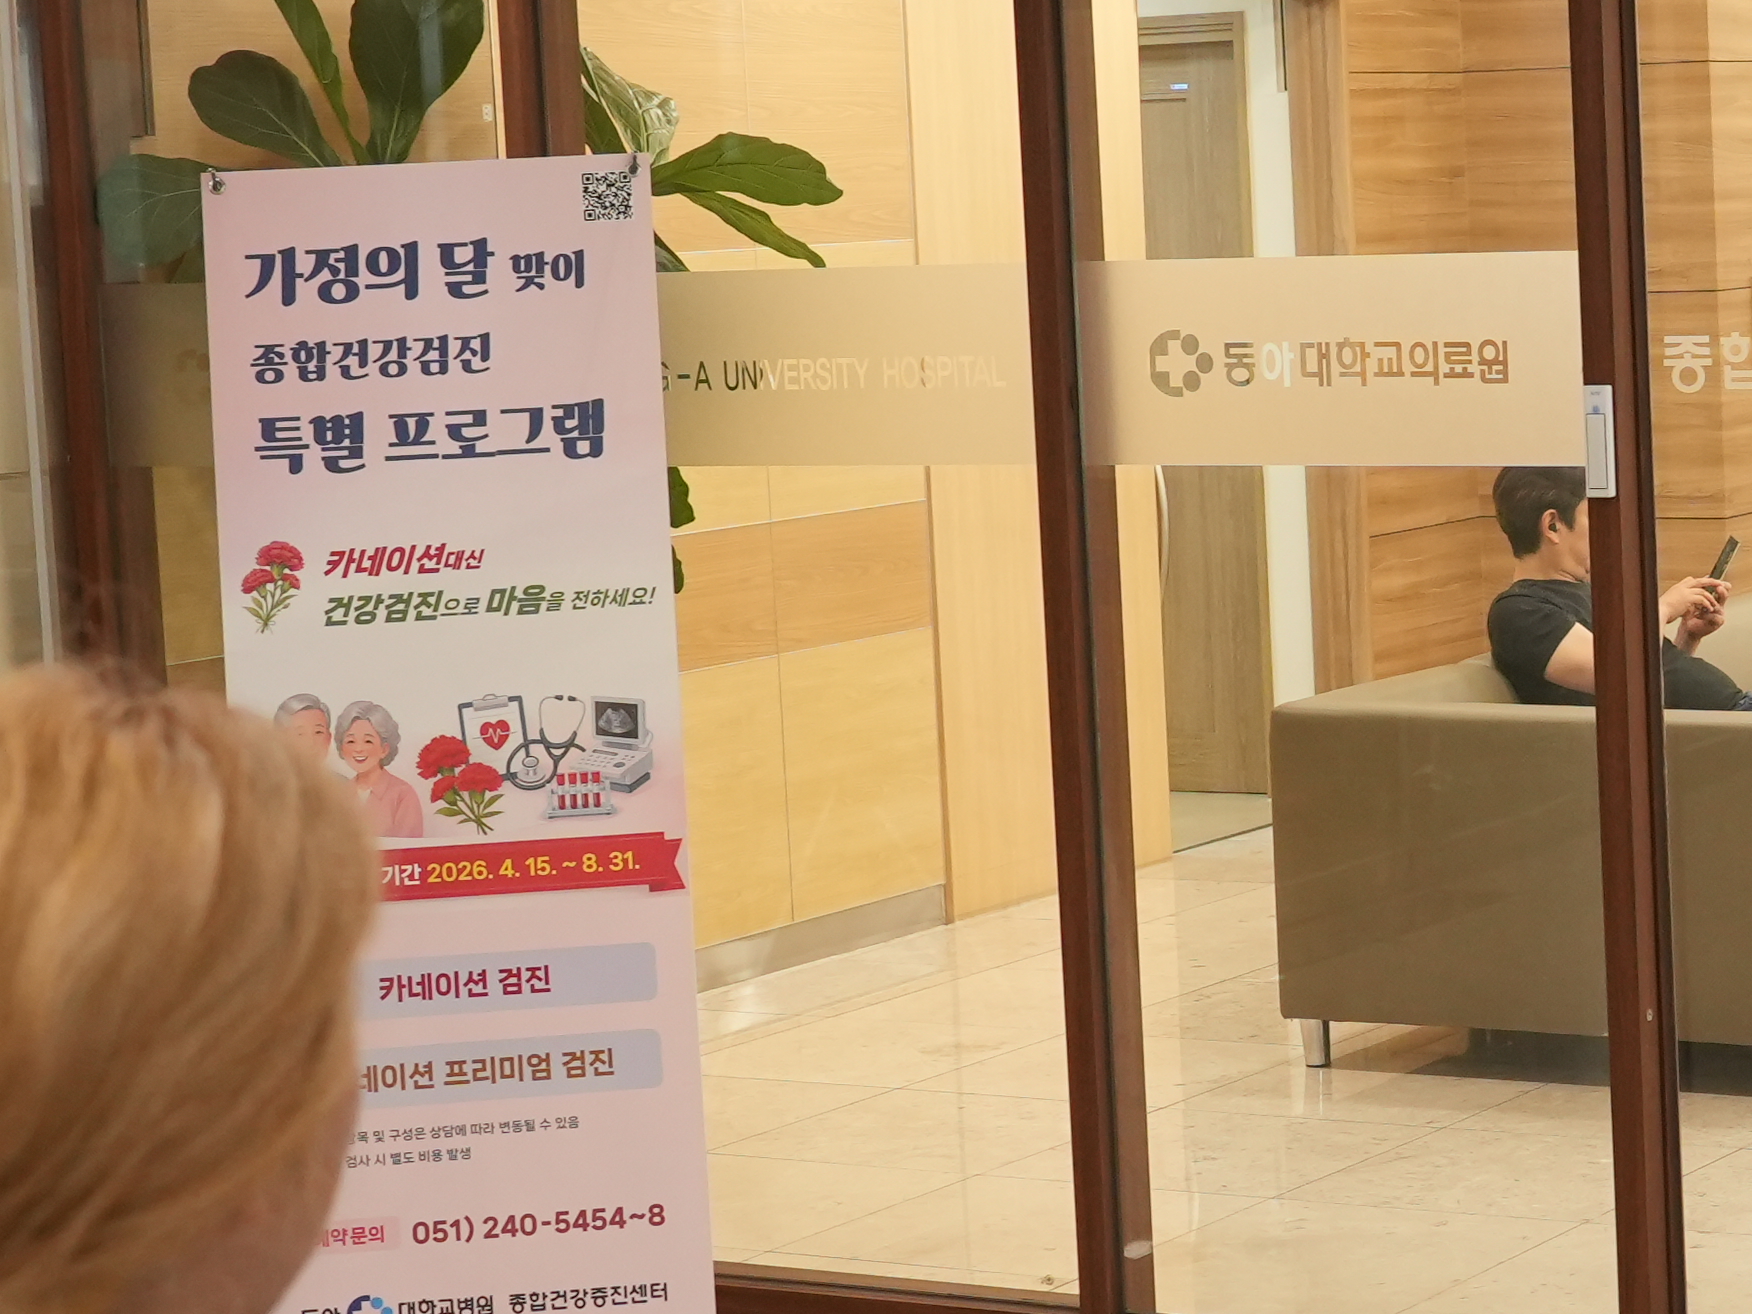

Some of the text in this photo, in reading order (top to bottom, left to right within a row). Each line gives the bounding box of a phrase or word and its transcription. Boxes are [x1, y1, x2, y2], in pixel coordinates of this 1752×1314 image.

[245, 237, 585, 307] 가정의 달 맞이
[250, 332, 492, 385] 종합건강검진
[723, 357, 869, 391] UNIVERSITY
[883, 355, 1006, 389] HOSPITAL
[1223, 337, 1510, 389] 동아대학교의료원
[254, 397, 606, 474] 특별 프로그램
[323, 583, 656, 627] 건강검진으로 마음을 전하세요!
[426, 857, 493, 884] 2026.
[499, 857, 521, 879] 4.
[526, 855, 557, 878] 15.
[581, 852, 604, 874] 8.
[609, 849, 641, 872] 31.
[378, 964, 553, 1004] 카네이션 검진
[444, 1053, 553, 1089] 프리미엄
[562, 1048, 616, 1080] 검진
[373, 1130, 385, 1143] 및
[389, 1127, 427, 1142] 구성은
[429, 1125, 467, 1139] 상담에
[471, 1123, 495, 1136] 따라
[499, 1119, 535, 1134] 변동될
[540, 1118, 552, 1130] 수
[555, 1116, 580, 1130] 있음
[374, 1152, 386, 1166] 시
[390, 1150, 415, 1166] 별도
[418, 1149, 443, 1163] 비용
[447, 1146, 472, 1161] 발생
[412, 1215, 475, 1244] 051)
[483, 1202, 667, 1241] 240-5454~8
[508, 1281, 669, 1314] 종합건강증진센터
